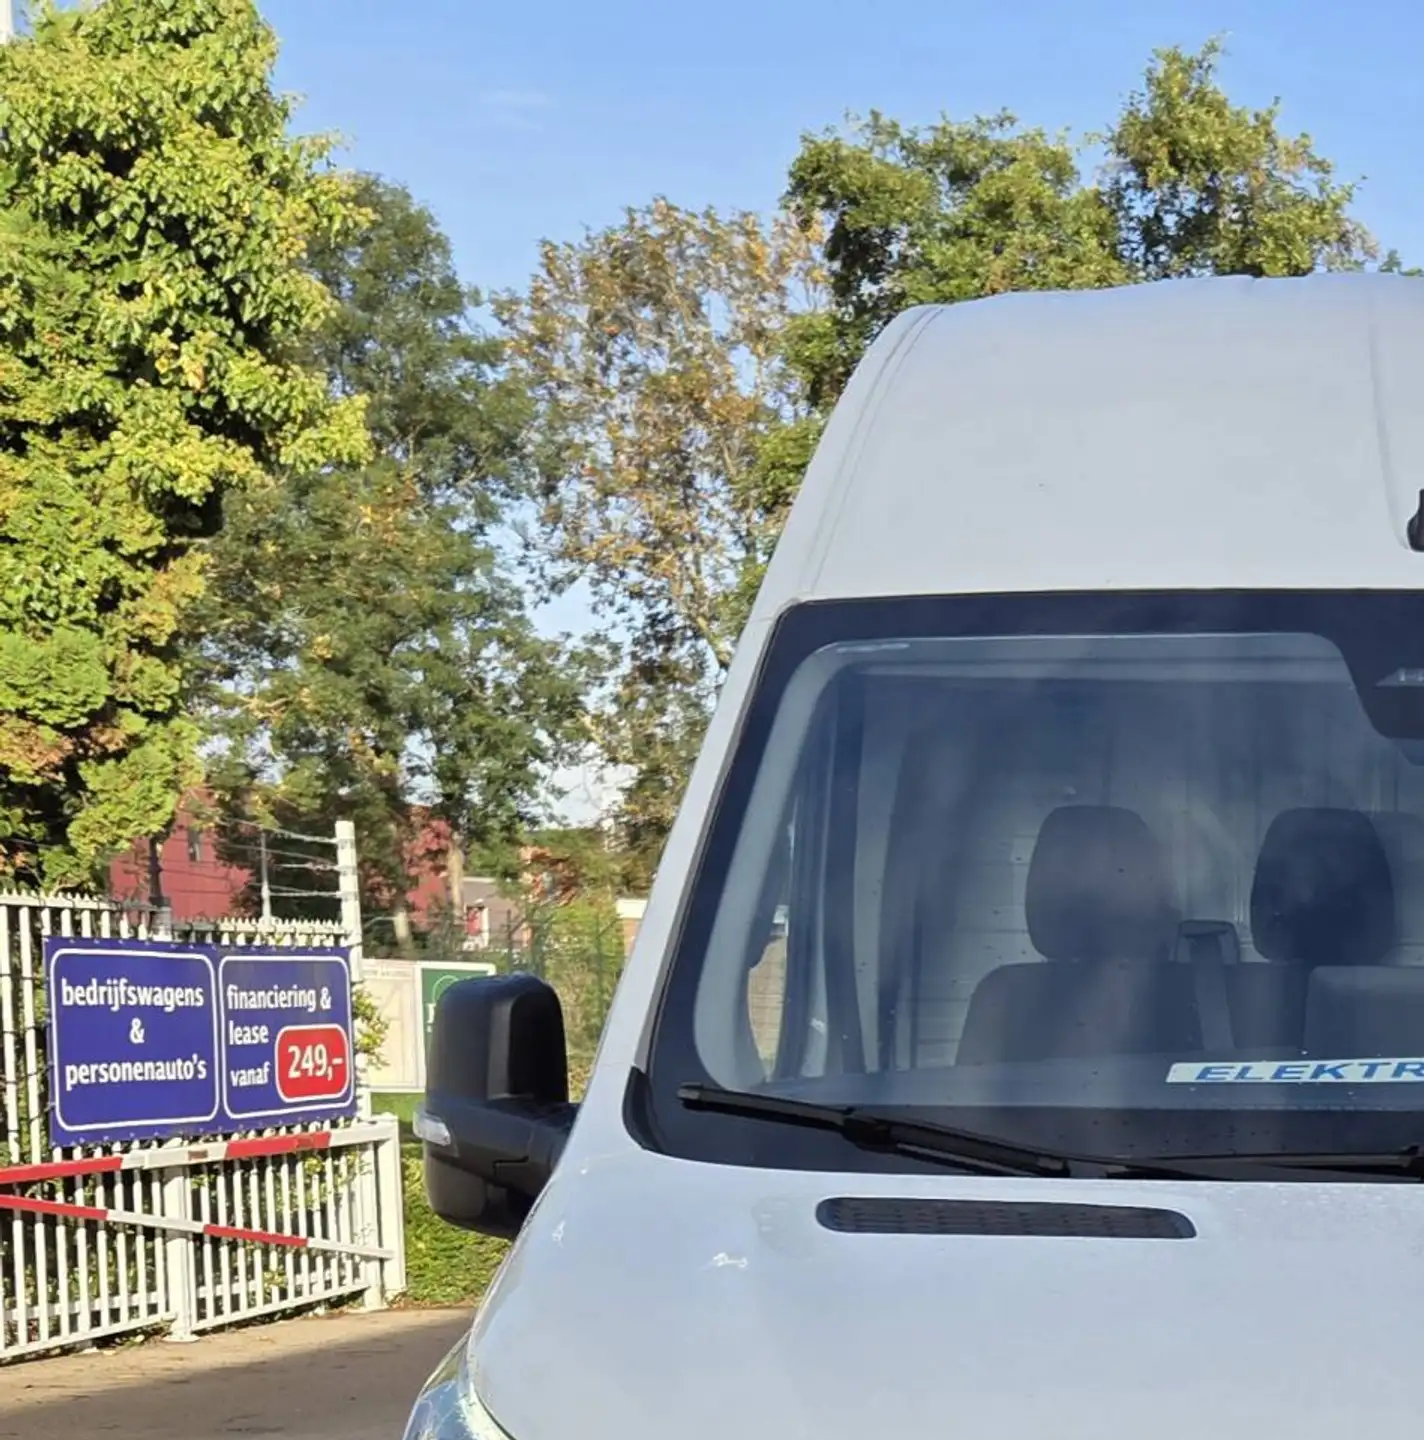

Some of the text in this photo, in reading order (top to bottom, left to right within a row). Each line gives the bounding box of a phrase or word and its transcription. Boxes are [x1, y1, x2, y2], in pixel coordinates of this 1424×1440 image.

[62, 979, 204, 1011] bedrijfswagens
[227, 984, 332, 1012] financiering &
[129, 1018, 145, 1044] &
[228, 1020, 270, 1046] lease
[65, 1054, 207, 1090] personenauto's
[230, 1061, 271, 1087] vanaf
[288, 1044, 343, 1079] 249,-
